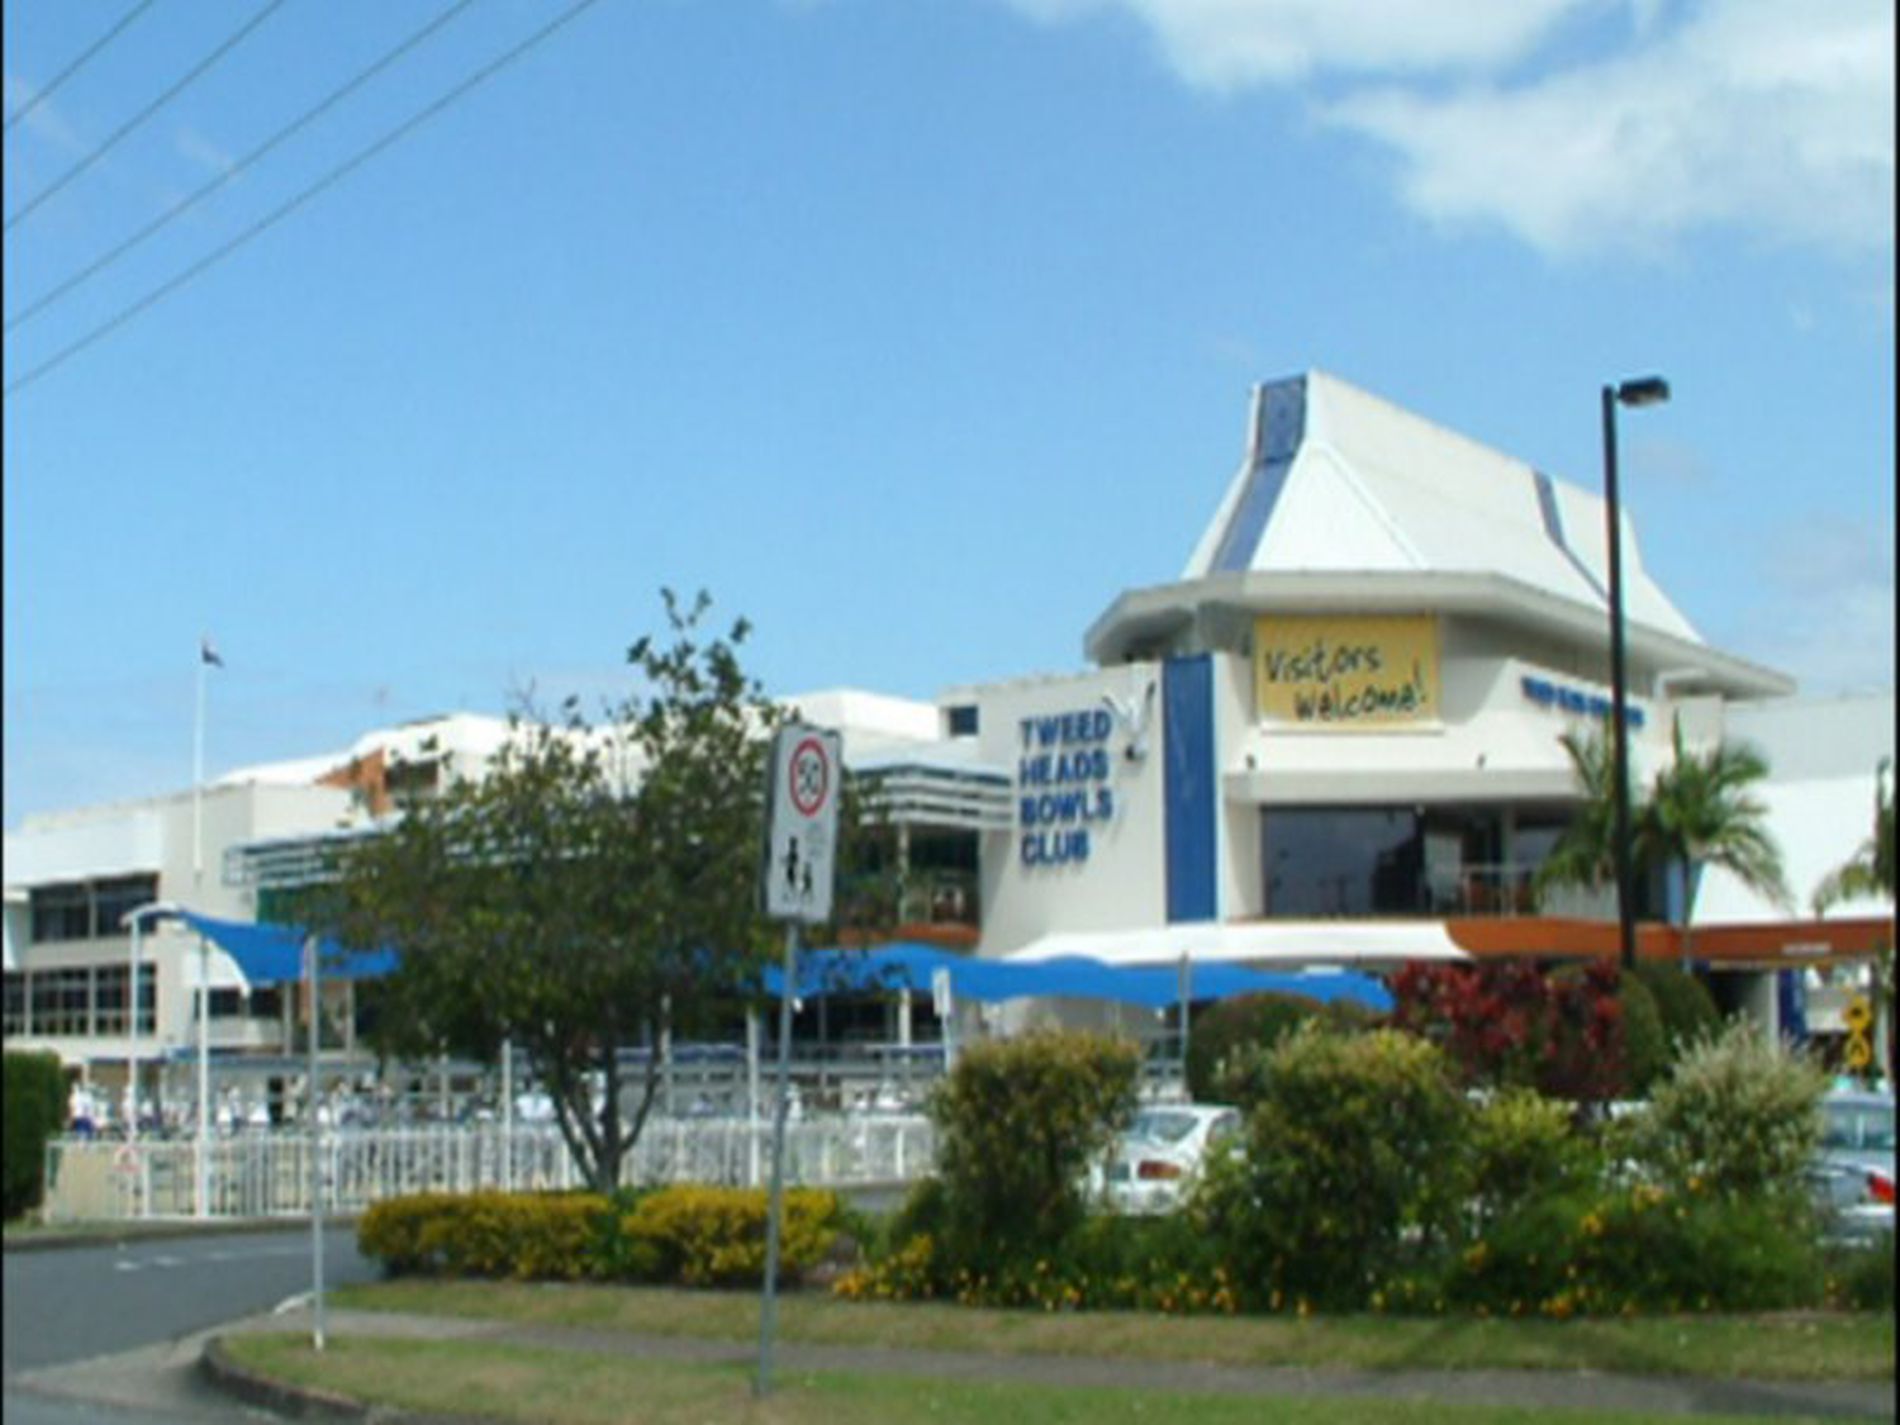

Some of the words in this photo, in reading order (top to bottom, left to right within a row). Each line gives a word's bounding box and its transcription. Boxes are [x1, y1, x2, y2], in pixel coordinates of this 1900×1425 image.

[1264, 638, 1380, 683] Visitors
[1019, 709, 1111, 747] TWEED
[1019, 748, 1108, 786] HEADS
[1020, 788, 1112, 825] BOWLS
[1021, 828, 1089, 866] CLUB
